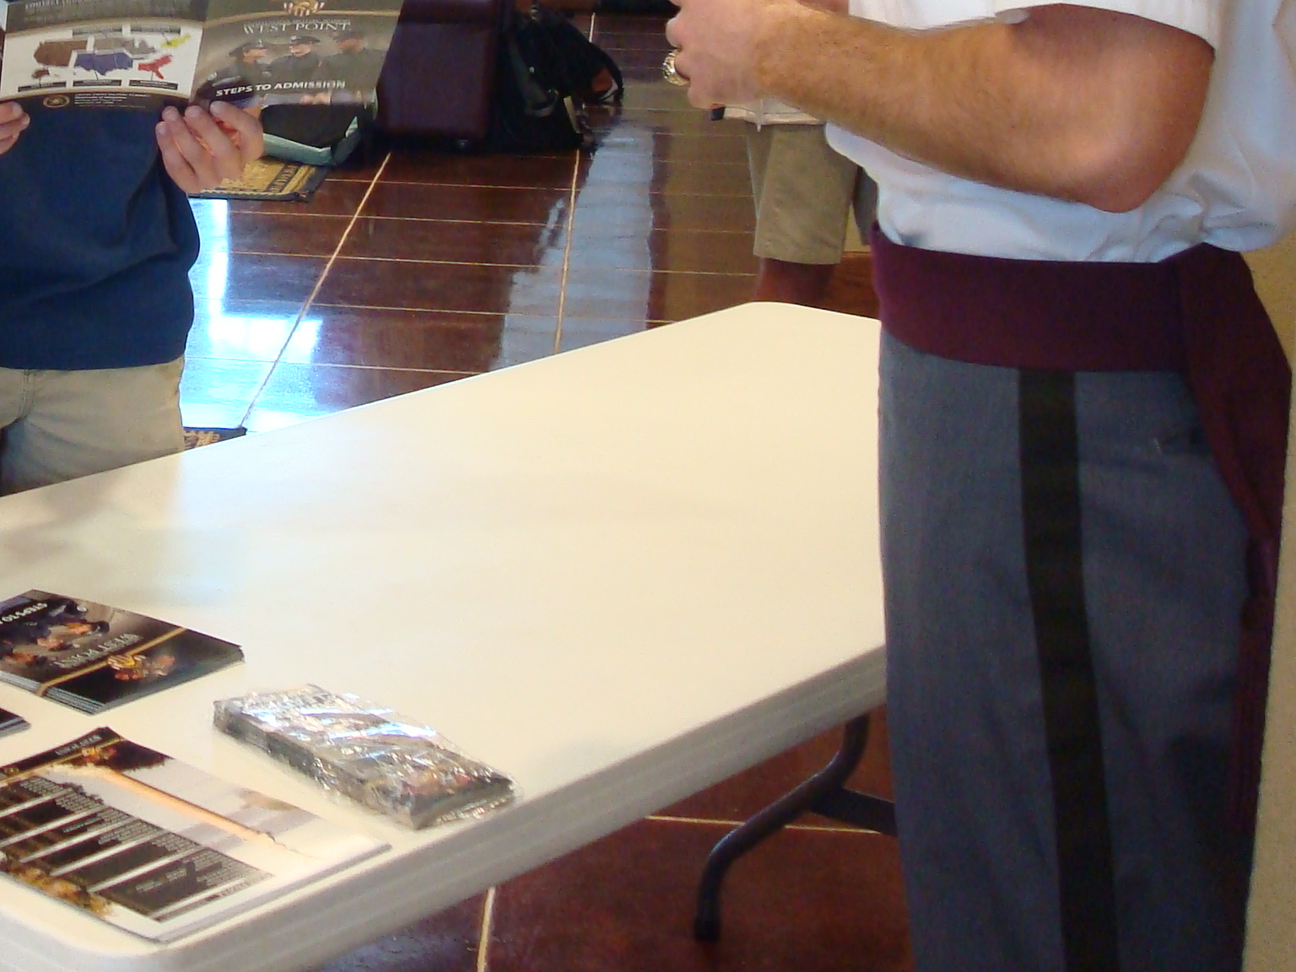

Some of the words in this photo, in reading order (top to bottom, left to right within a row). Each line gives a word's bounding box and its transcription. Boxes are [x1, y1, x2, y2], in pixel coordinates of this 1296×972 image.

[243, 21, 287, 35] WEST
[294, 21, 352, 32] POINT
[215, 85, 253, 97] STEPS
[255, 83, 271, 91] TO
[273, 79, 346, 90] ADMISSION
